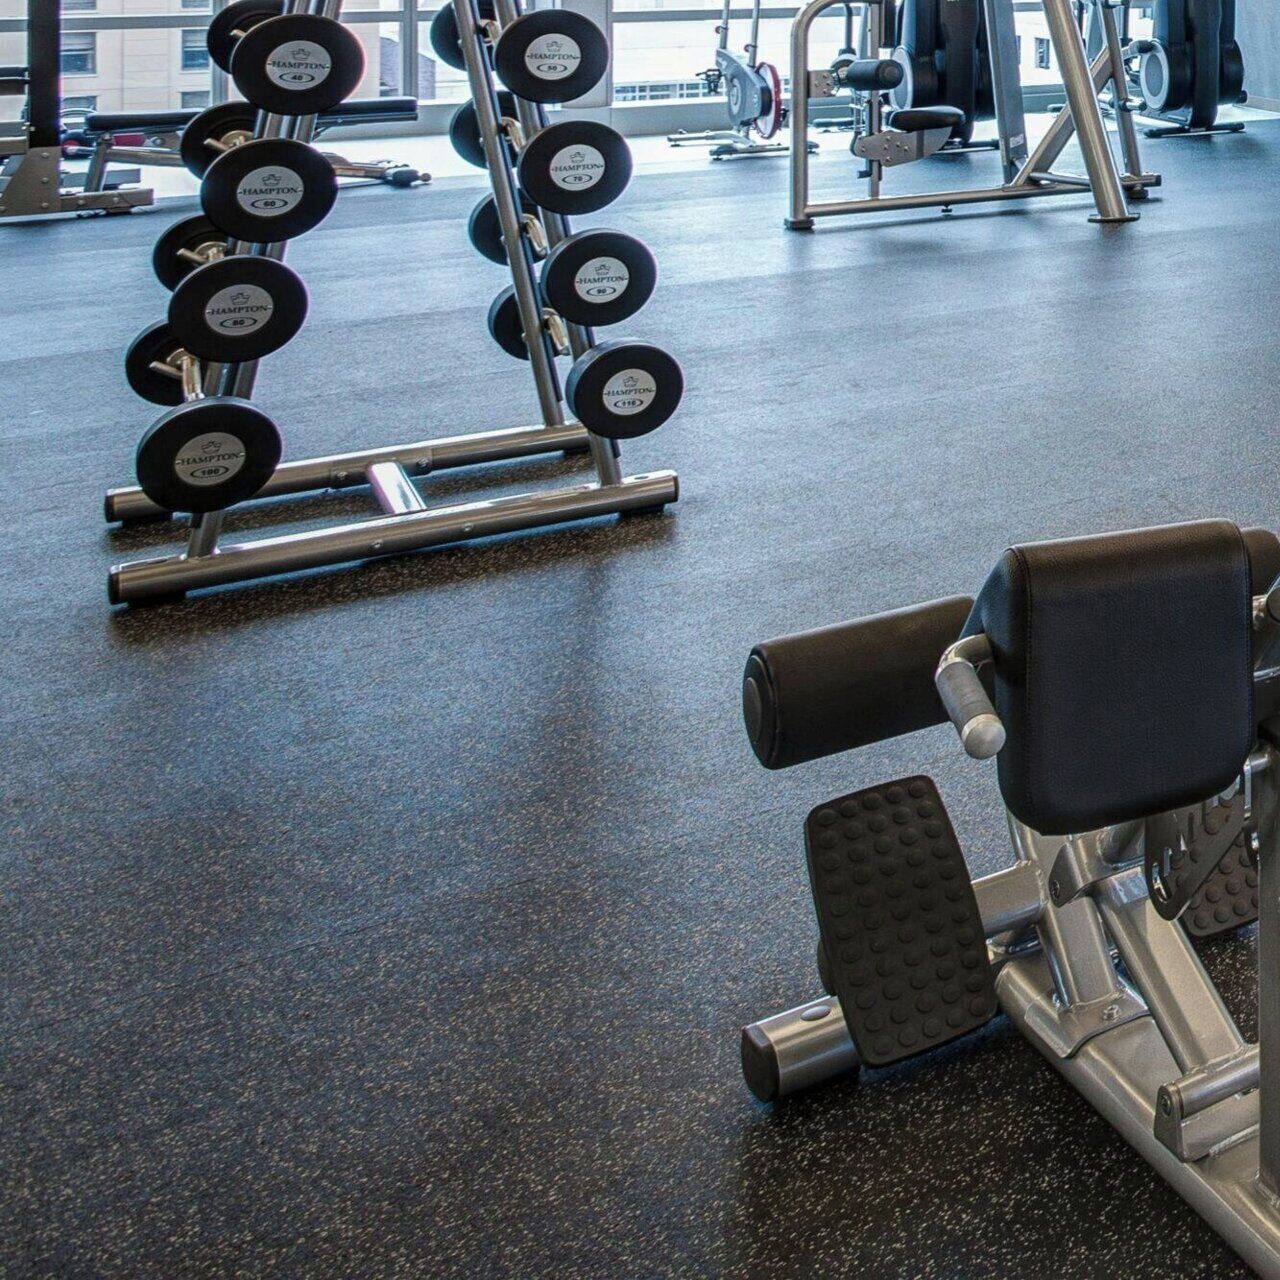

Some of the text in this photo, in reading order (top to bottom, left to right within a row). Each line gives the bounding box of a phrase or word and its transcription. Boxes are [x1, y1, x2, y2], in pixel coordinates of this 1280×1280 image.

[529, 52, 576, 61] HAMPTON
[271, 60, 326, 70] HAMPTON
[554, 163, 600, 173] HAMPTON
[242, 186, 300, 196] HAMPTON
[578, 275, 625, 285] HAMPTON
[210, 304, 268, 315] HAMPTON
[606, 386, 653, 397] HAMPTON
[181, 452, 239, 466] HAMPTON
